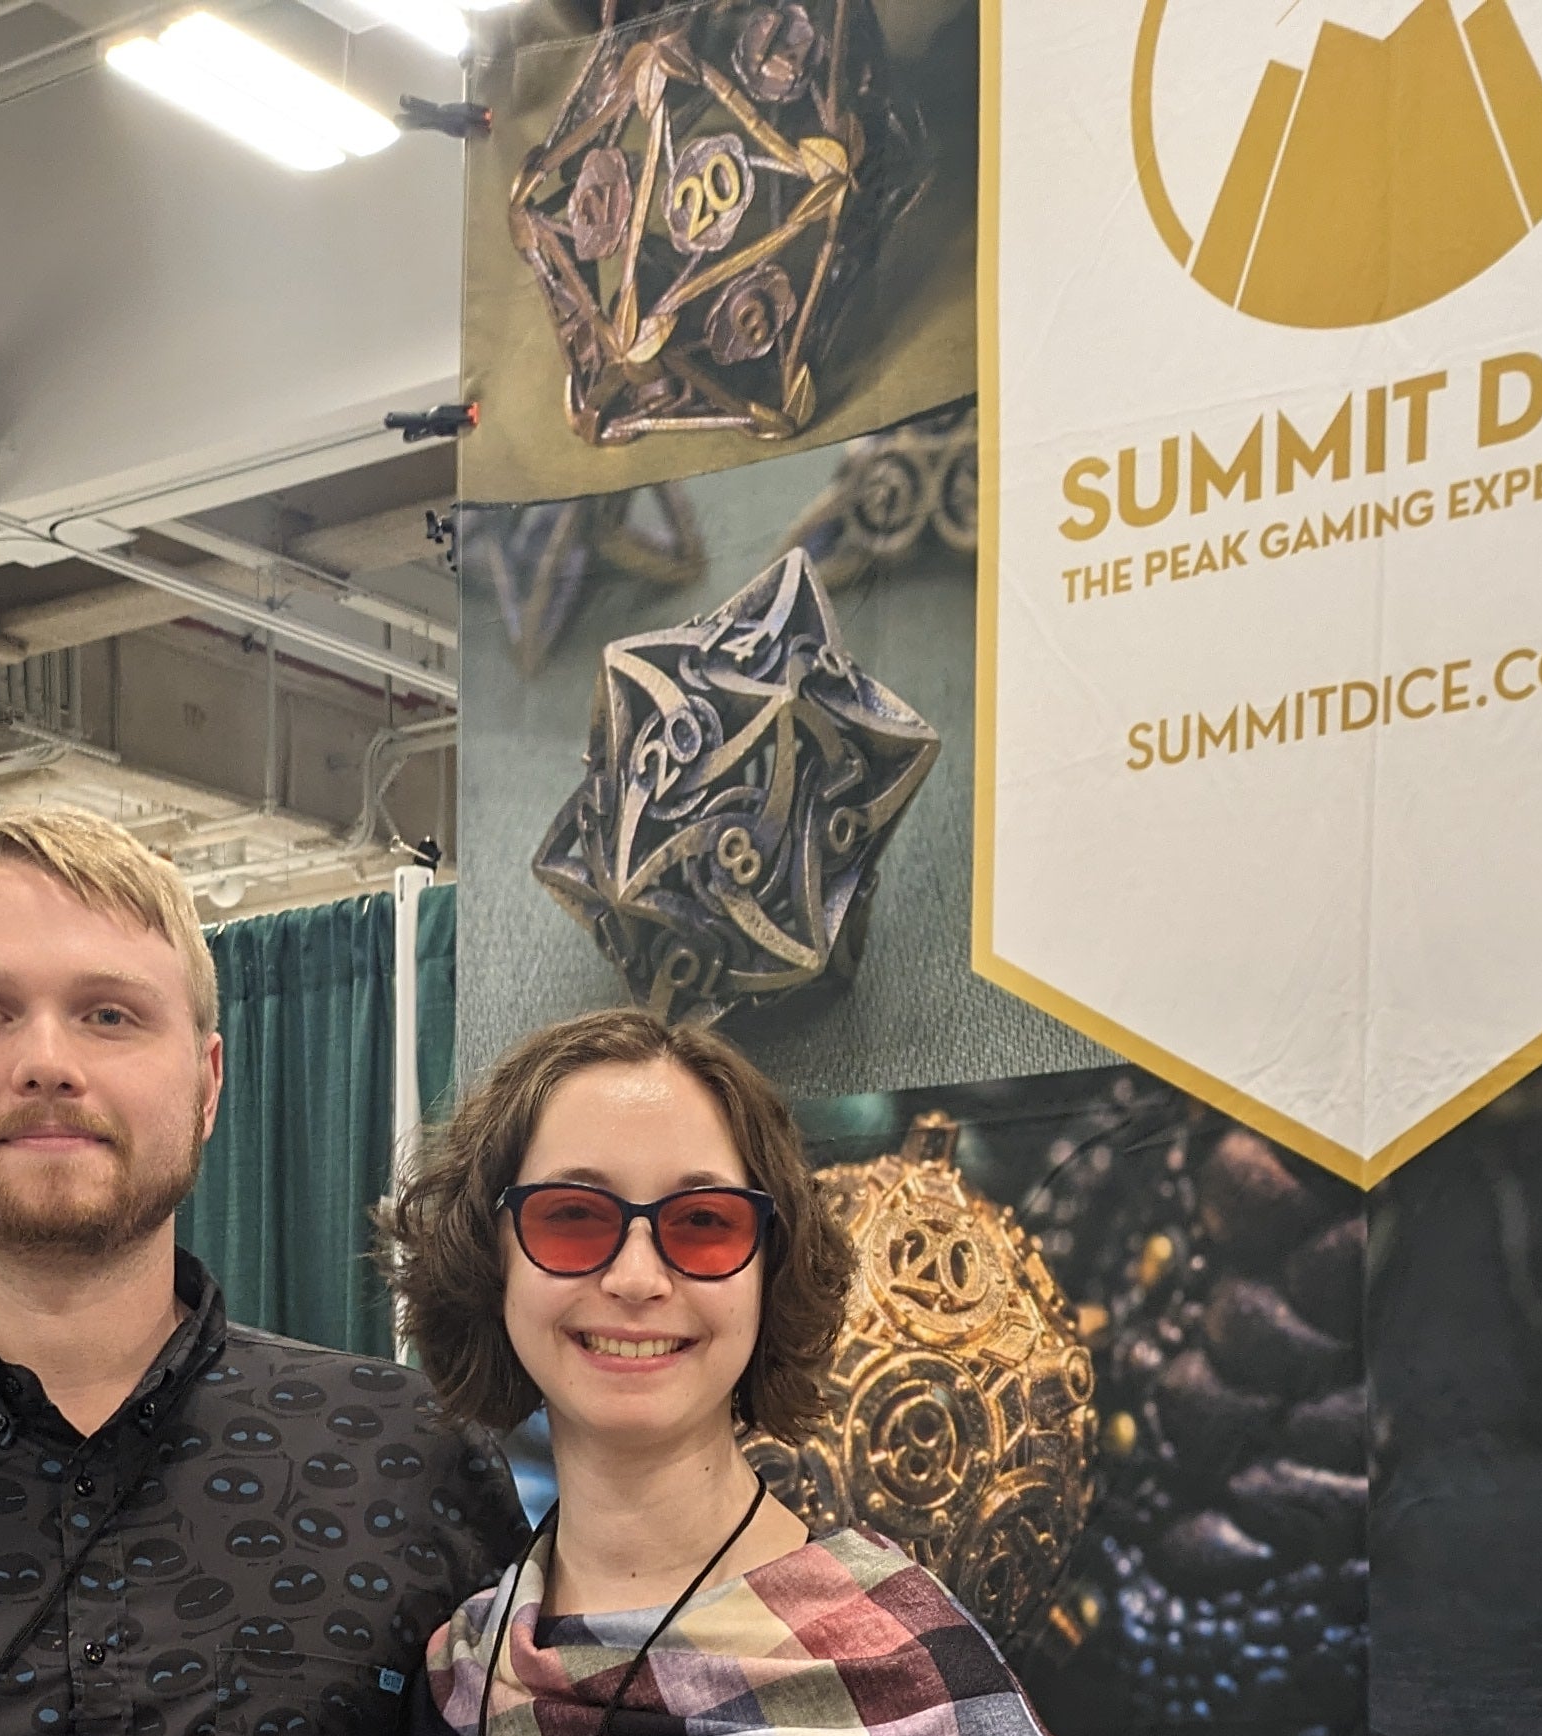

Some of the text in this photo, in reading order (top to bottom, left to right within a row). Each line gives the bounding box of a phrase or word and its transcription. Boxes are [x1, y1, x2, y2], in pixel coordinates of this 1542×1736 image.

[1057, 370, 1447, 541] SUMMIT
[1062, 555, 1133, 605] THE
[1144, 530, 1250, 590] PEAK
[1259, 488, 1435, 561] GAMING
